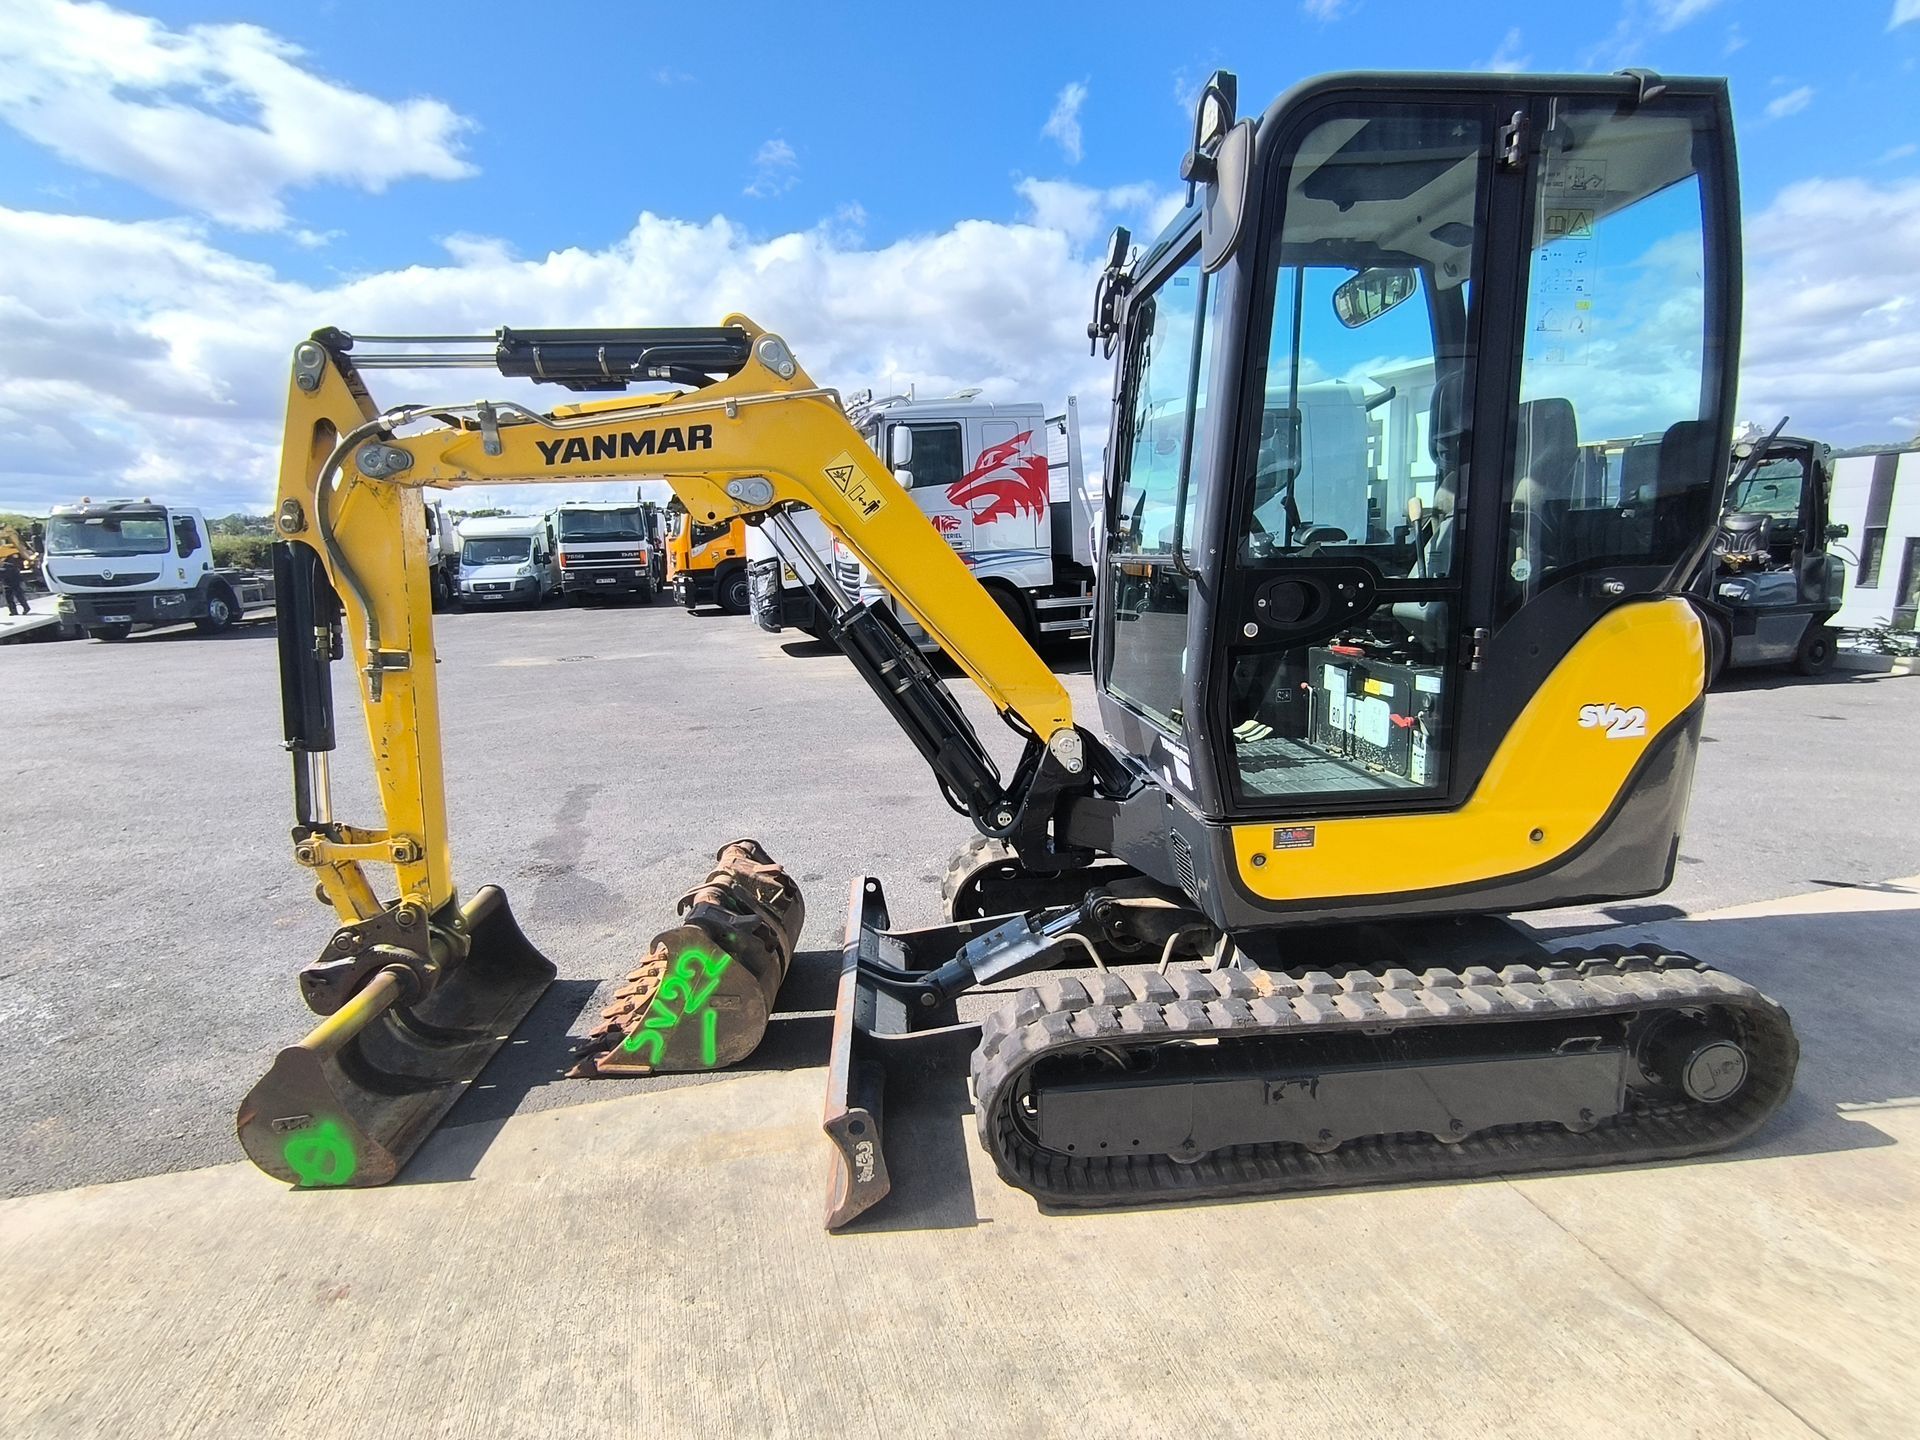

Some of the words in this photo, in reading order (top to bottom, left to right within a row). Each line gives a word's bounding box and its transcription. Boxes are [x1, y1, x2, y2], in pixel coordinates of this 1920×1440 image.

[535, 424, 713, 466] YANMAR
[1577, 702, 1647, 740] SV22
[624, 949, 732, 1065] SV22
